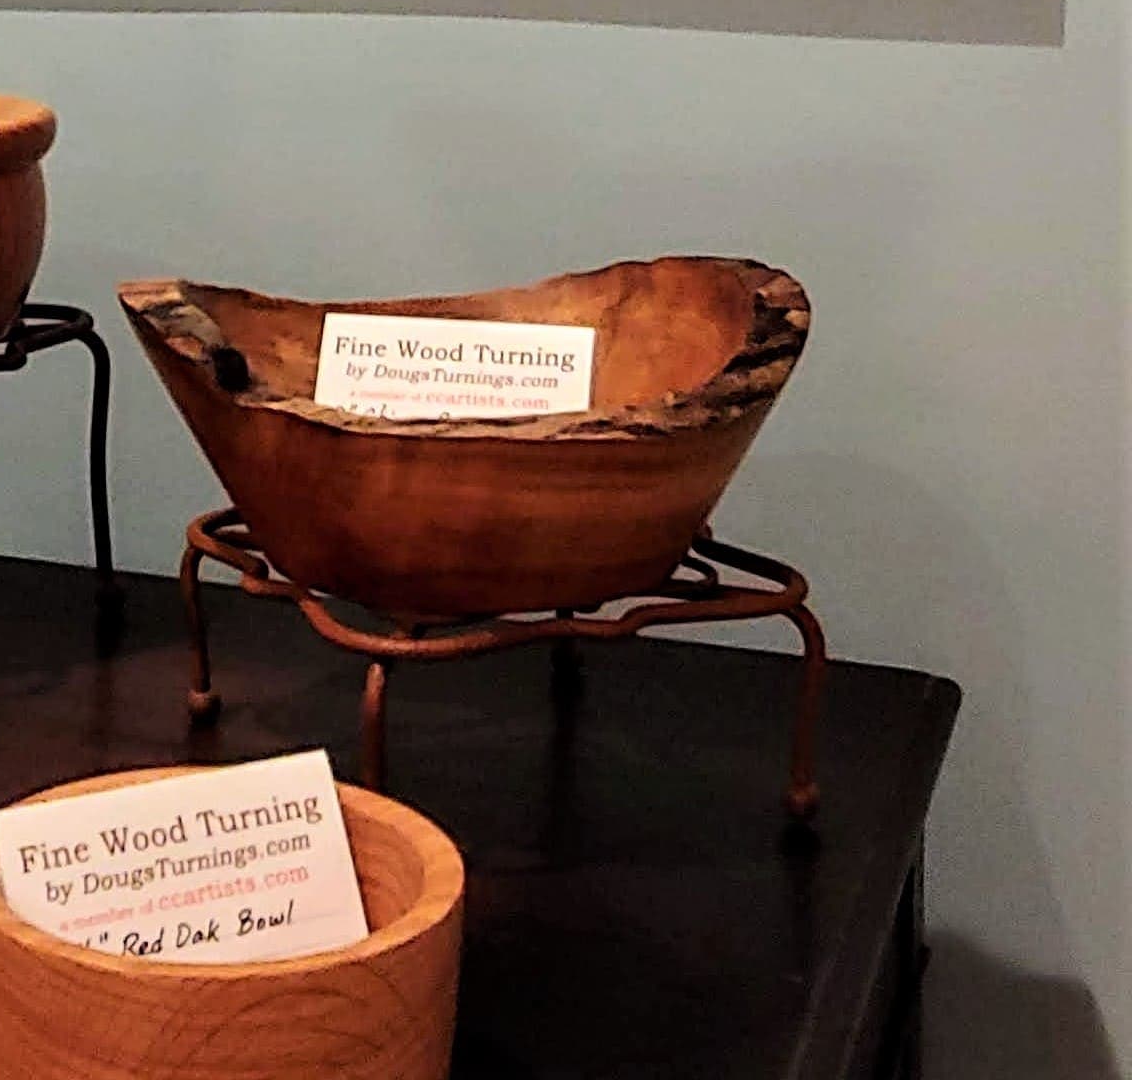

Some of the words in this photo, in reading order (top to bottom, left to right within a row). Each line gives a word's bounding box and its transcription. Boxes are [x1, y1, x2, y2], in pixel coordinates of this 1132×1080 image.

[335, 336, 387, 358] Fine
[398, 339, 463, 362] Wood
[474, 344, 576, 372] Turning
[346, 362, 368, 380] by
[374, 363, 559, 389] DougsTurnings.com
[425, 390, 549, 410] ccartists.com
[17, 843, 90, 874] Fine
[99, 816, 188, 857] Wood
[196, 794, 323, 838] Turning
[45, 880, 74, 903] by
[83, 831, 311, 895] DougsTurnings.com
[157, 867, 308, 911] ccartists.com
[122, 927, 164, 955] Red
[236, 899, 295, 936] Bowl
